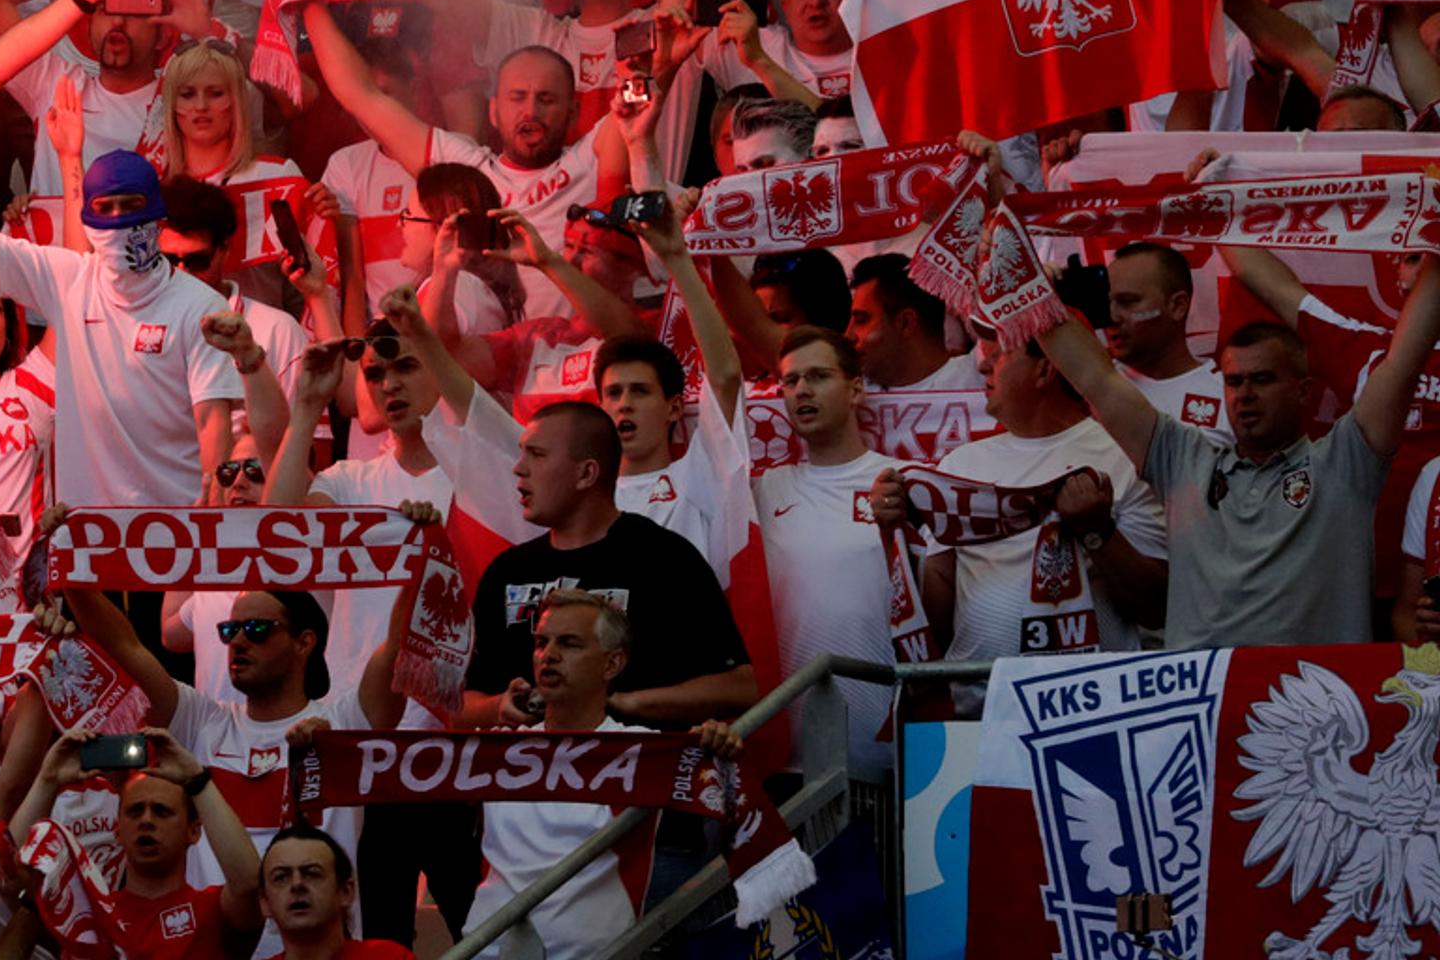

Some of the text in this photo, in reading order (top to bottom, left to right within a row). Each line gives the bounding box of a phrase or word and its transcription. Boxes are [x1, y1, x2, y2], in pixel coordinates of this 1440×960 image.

[991, 281, 1051, 320] POLSKA
[66, 511, 425, 584] POLSKA
[1037, 661, 1199, 722] KKS LECH
[355, 738, 644, 794] POLSKA
[672, 745, 705, 803] POLSKA
